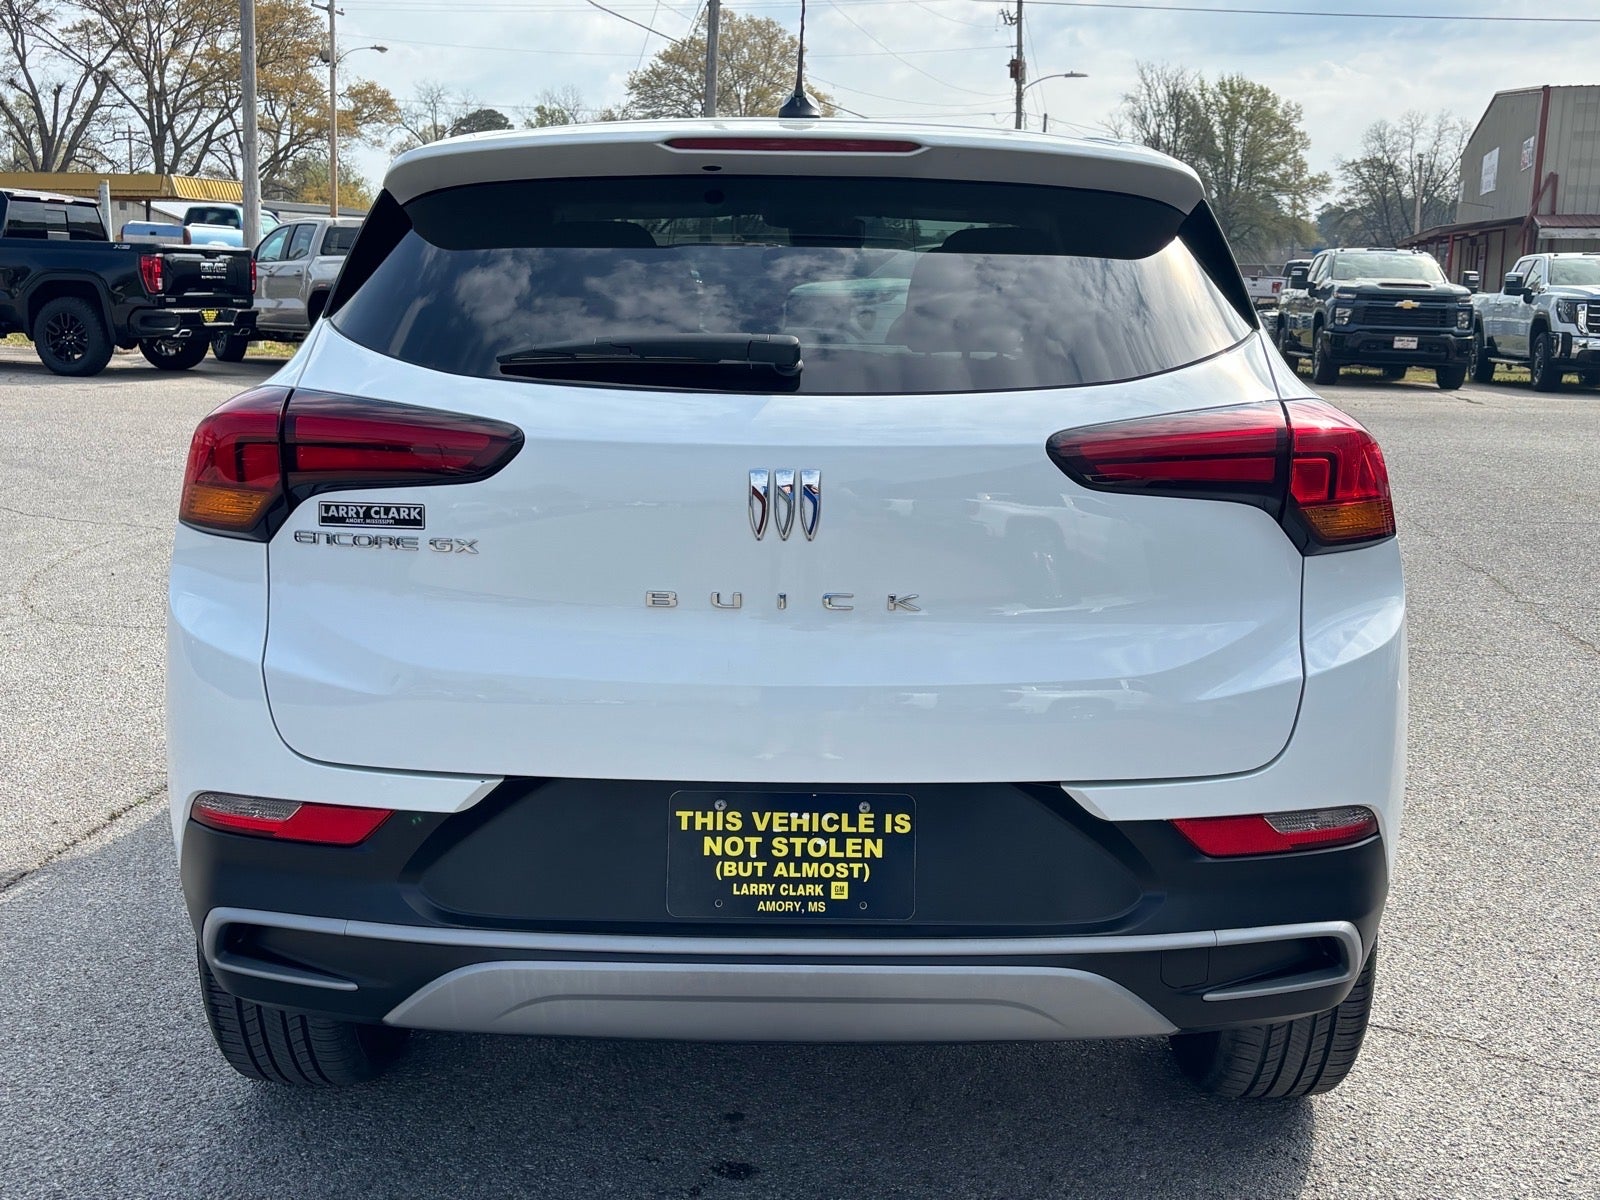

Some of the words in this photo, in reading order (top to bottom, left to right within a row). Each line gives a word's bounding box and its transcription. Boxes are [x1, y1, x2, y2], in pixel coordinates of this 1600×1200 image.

[321, 504, 367, 518] LARRY
[370, 506, 422, 520] CLARK
[295, 531, 419, 551] ENCORE
[428, 537, 480, 555] GX
[645, 590, 922, 612] BUICK
[676, 810, 743, 832] THIS
[752, 811, 875, 833] VEHICLE
[885, 813, 912, 834] IS
[703, 836, 763, 858] NOT
[771, 837, 883, 859] STOLEN
[715, 860, 768, 881] (BUT
[773, 861, 871, 882] ALMOST)
[733, 883, 776, 896] LARRY
[780, 883, 824, 897] CLARK
[834, 885, 845, 894] GM
[757, 901, 805, 914] AMORY,
[808, 901, 826, 913] MS
